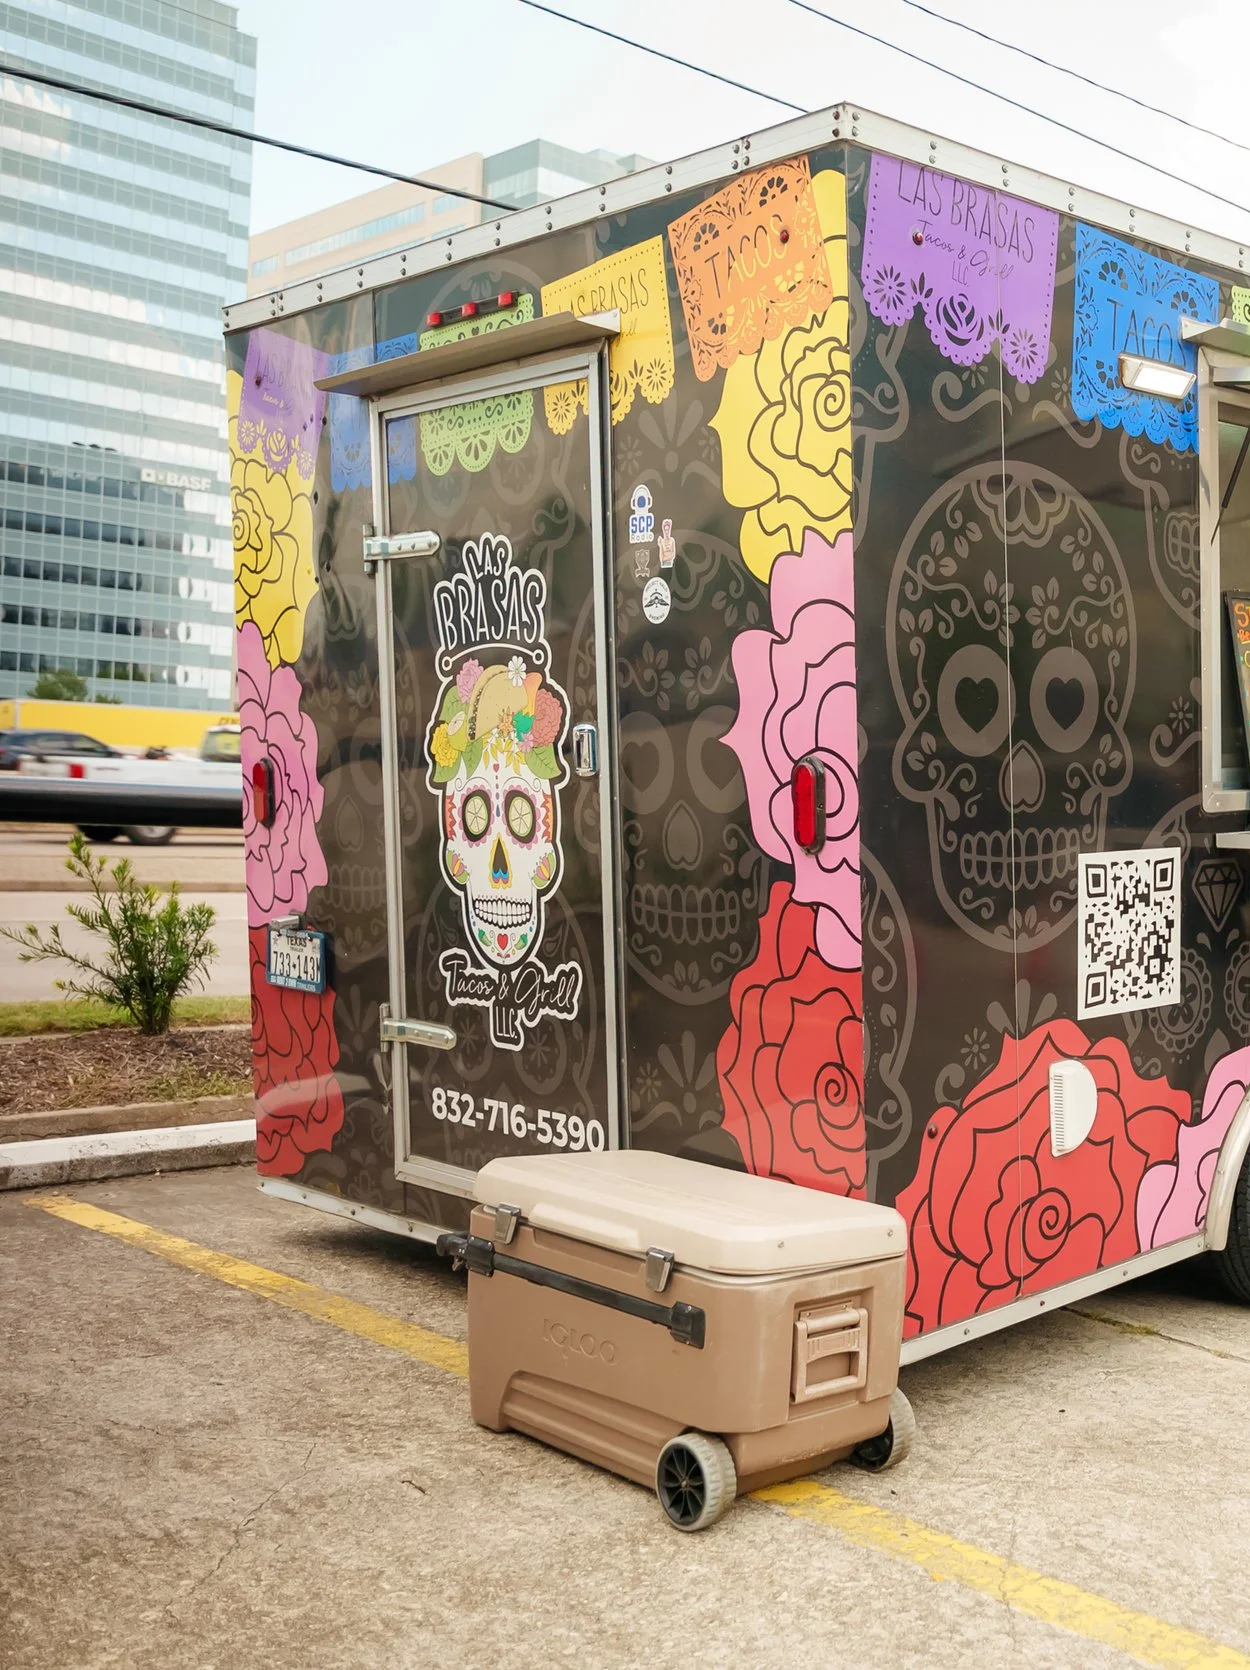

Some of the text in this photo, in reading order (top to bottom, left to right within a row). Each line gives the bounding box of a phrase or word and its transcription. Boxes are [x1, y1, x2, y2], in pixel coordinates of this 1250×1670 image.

[898, 160, 1035, 264] LAS BRASAS
[705, 213, 788, 299] TACOS
[166, 472, 212, 492] BASF
[631, 515, 653, 534] SCP
[468, 544, 505, 580] LAS
[440, 578, 540, 651] BRASAS
[287, 936, 307, 947] TEXAS
[445, 960, 576, 1016] Tacos & Grill
[495, 1006, 518, 1039] LLC.
[432, 1087, 605, 1153] 832-716-5390
[543, 1318, 618, 1366] IGLOO
